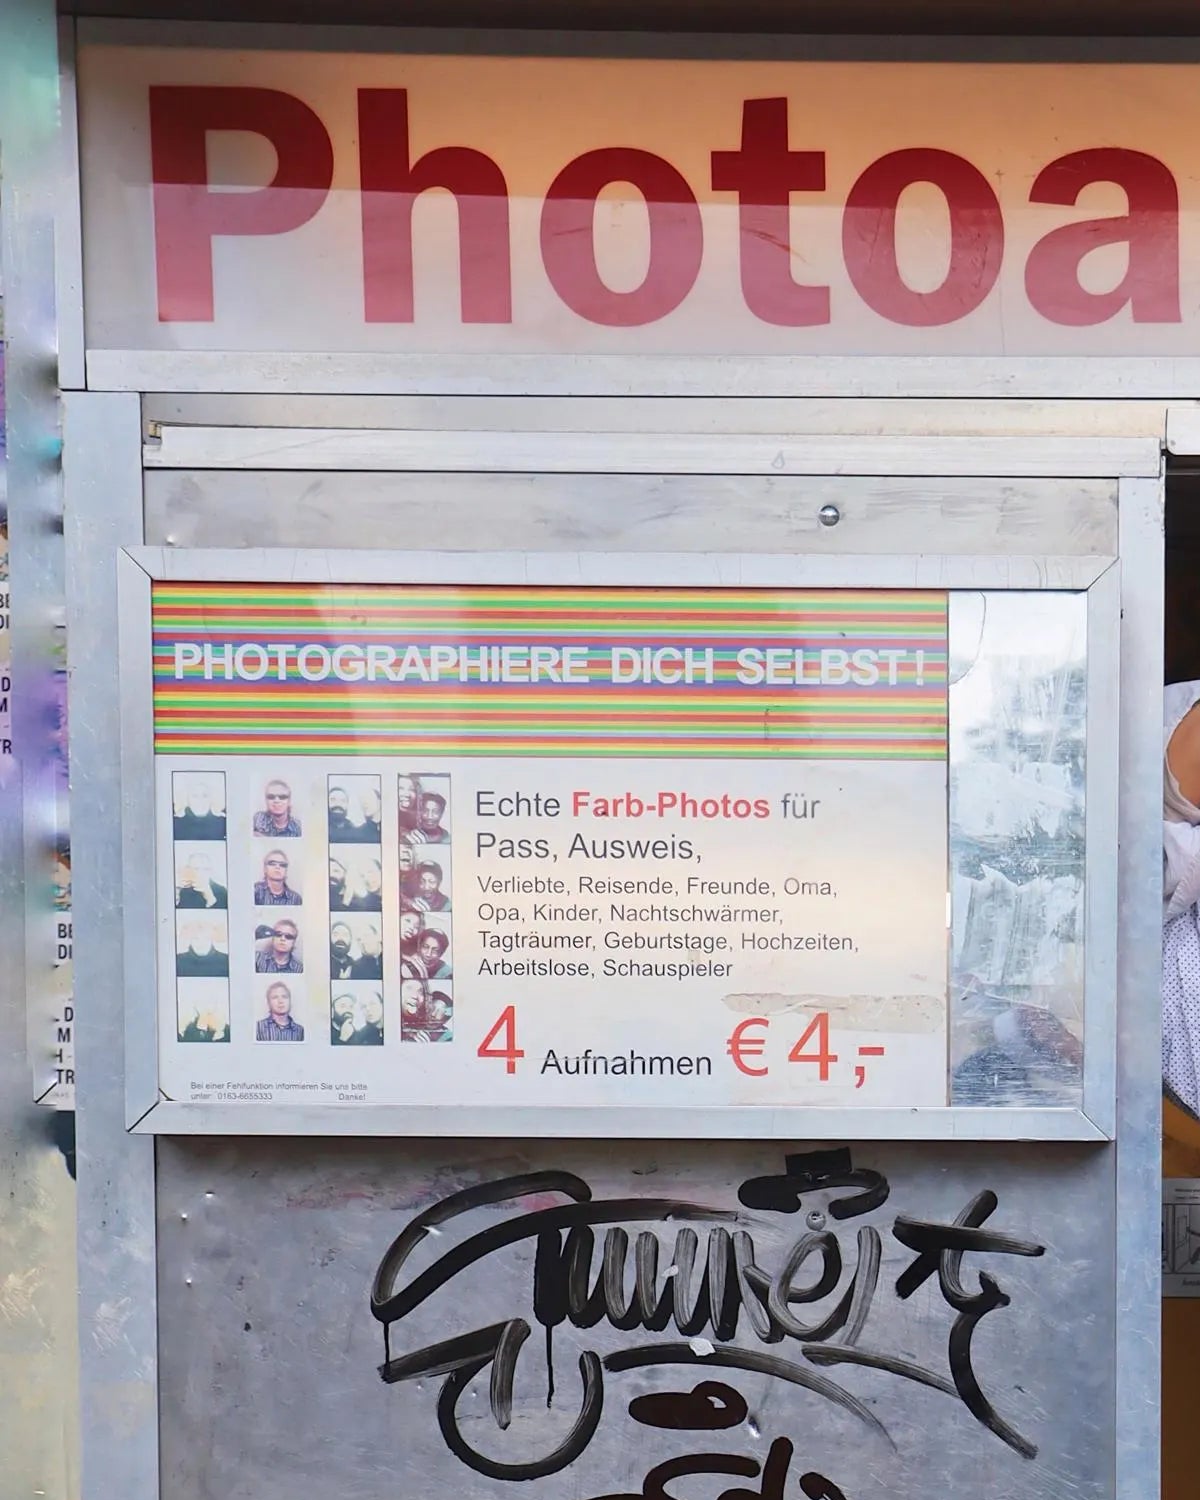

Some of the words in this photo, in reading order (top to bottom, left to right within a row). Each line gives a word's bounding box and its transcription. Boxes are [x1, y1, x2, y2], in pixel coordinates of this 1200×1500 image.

[174, 642, 590, 682] PHOTOGRAPHIERE
[611, 646, 714, 685] DICH
[736, 647, 925, 687] SELBST!
[475, 791, 561, 817] Echte
[572, 791, 771, 819] Farb-Photos
[781, 793, 821, 818] für
[476, 832, 558, 862] Pass,
[568, 833, 703, 863] Ausweis,
[477, 875, 570, 897] Verliebte,
[578, 876, 679, 897] Reisende,
[687, 877, 776, 898] Freunde,
[783, 877, 838, 898] Oma,
[477, 904, 525, 925] Opa,
[533, 903, 602, 924] Kinder,
[610, 904, 784, 925] Nachtschwärmer,
[478, 930, 596, 952] Tagträumer,
[604, 932, 733, 953] Geburtstage,
[741, 933, 859, 953] Hochzeiten,
[478, 959, 595, 979] Arbeitslose,
[602, 959, 733, 980] Schauspieler
[477, 1005, 525, 1074] 4
[540, 1049, 712, 1076] Aufnahmen
